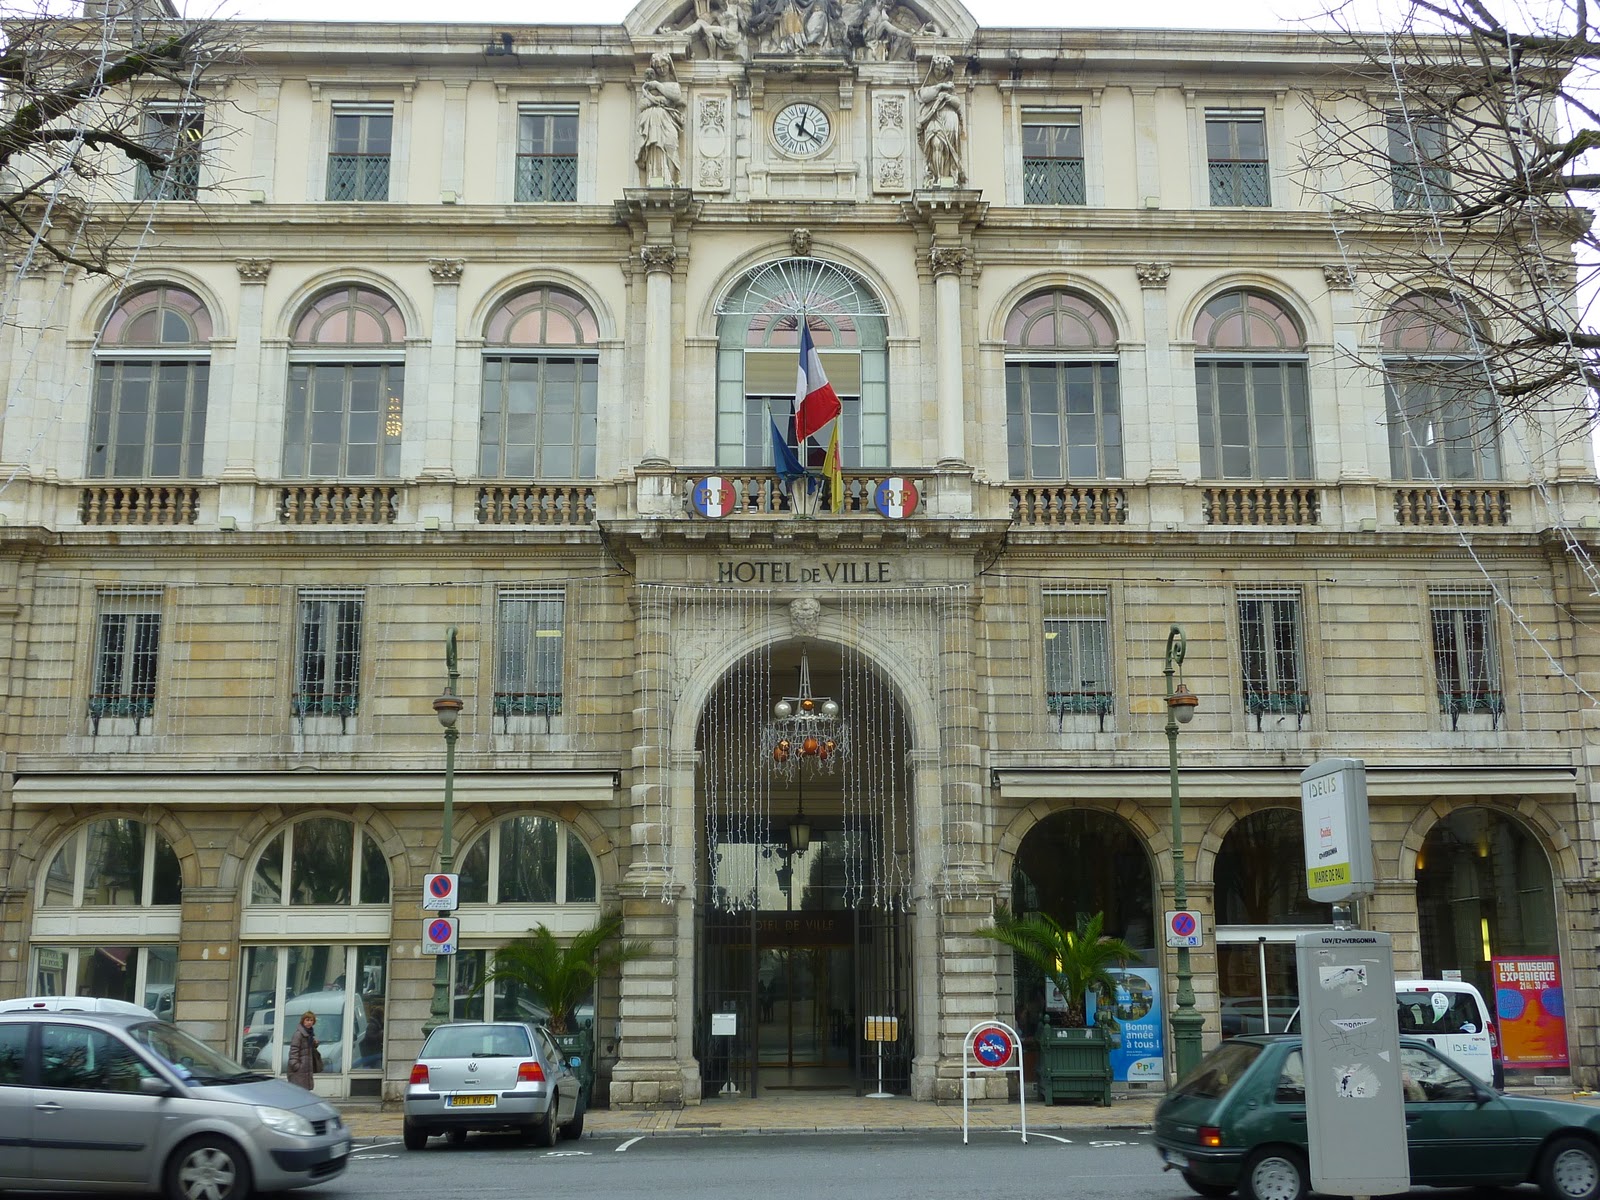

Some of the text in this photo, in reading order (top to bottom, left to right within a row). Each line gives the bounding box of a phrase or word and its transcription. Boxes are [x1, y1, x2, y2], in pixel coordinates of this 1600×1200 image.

[717, 562, 892, 583] HOTEL DE VILLE
[1309, 777, 1337, 799] IDELIS
[1313, 867, 1345, 884] MAIRIE DE PAU
[1498, 961, 1555, 972] THE MUSEUM
[1500, 972, 1556, 982] EXPERIENCE
[1126, 1031, 1153, 1039] année
[1127, 1040, 1131, 1048] à
[452, 1095, 470, 1105] 9781
